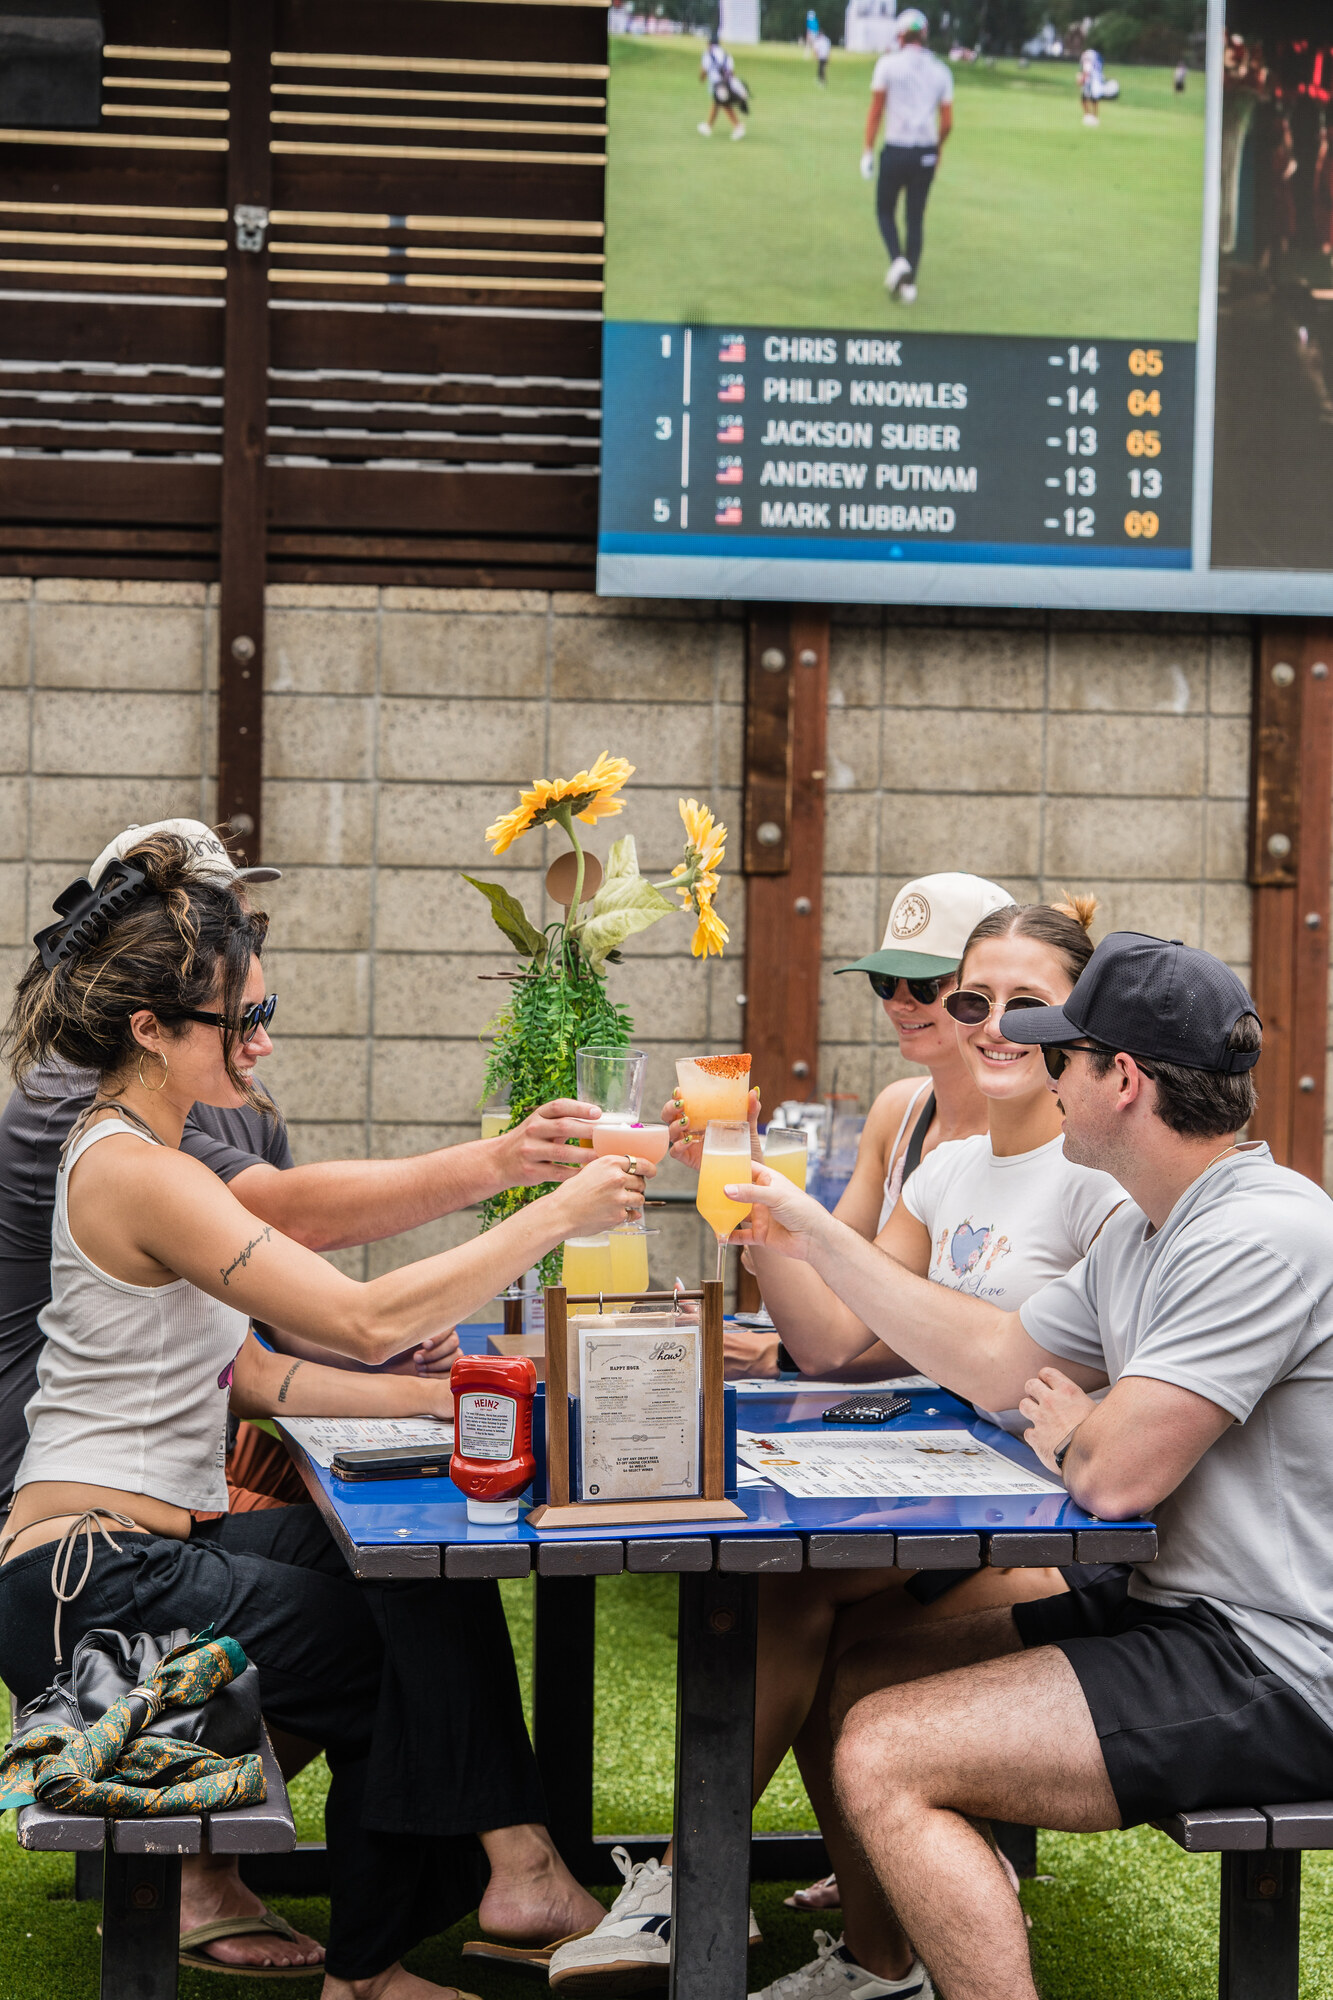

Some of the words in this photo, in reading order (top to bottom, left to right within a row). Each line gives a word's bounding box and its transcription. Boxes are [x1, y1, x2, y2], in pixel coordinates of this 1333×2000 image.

[660, 334, 671, 359] 1
[763, 335, 837, 364] CHRIS
[845, 339, 902, 366] KIRK
[1048, 346, 1099, 375] -14
[1128, 349, 1163, 377] 65
[763, 376, 841, 405] PHILIP
[849, 380, 967, 410] KNOWLES
[1047, 386, 1098, 416] -14
[1127, 389, 1161, 417] 64
[655, 416, 672, 441] 3
[760, 419, 873, 449] JACKSON
[880, 423, 960, 452] SUBER
[1046, 426, 1097, 456] -13
[1126, 430, 1161, 458] 65
[760, 460, 868, 490] ANDREW
[875, 464, 977, 493] PUTNAM
[1045, 467, 1097, 497] -13
[1128, 469, 1162, 498] 13
[653, 498, 670, 523] 5
[760, 501, 830, 529] MARK
[839, 504, 955, 533] HUBBARD
[1044, 507, 1095, 537] -12
[1124, 511, 1159, 538] 69
[967, 1274, 1007, 1298] Love
[649, 1341, 677, 1360] yee
[656, 1349, 682, 1361] haw
[474, 1399, 500, 1410] HEINZ
[470, 1475, 494, 1493] 57
